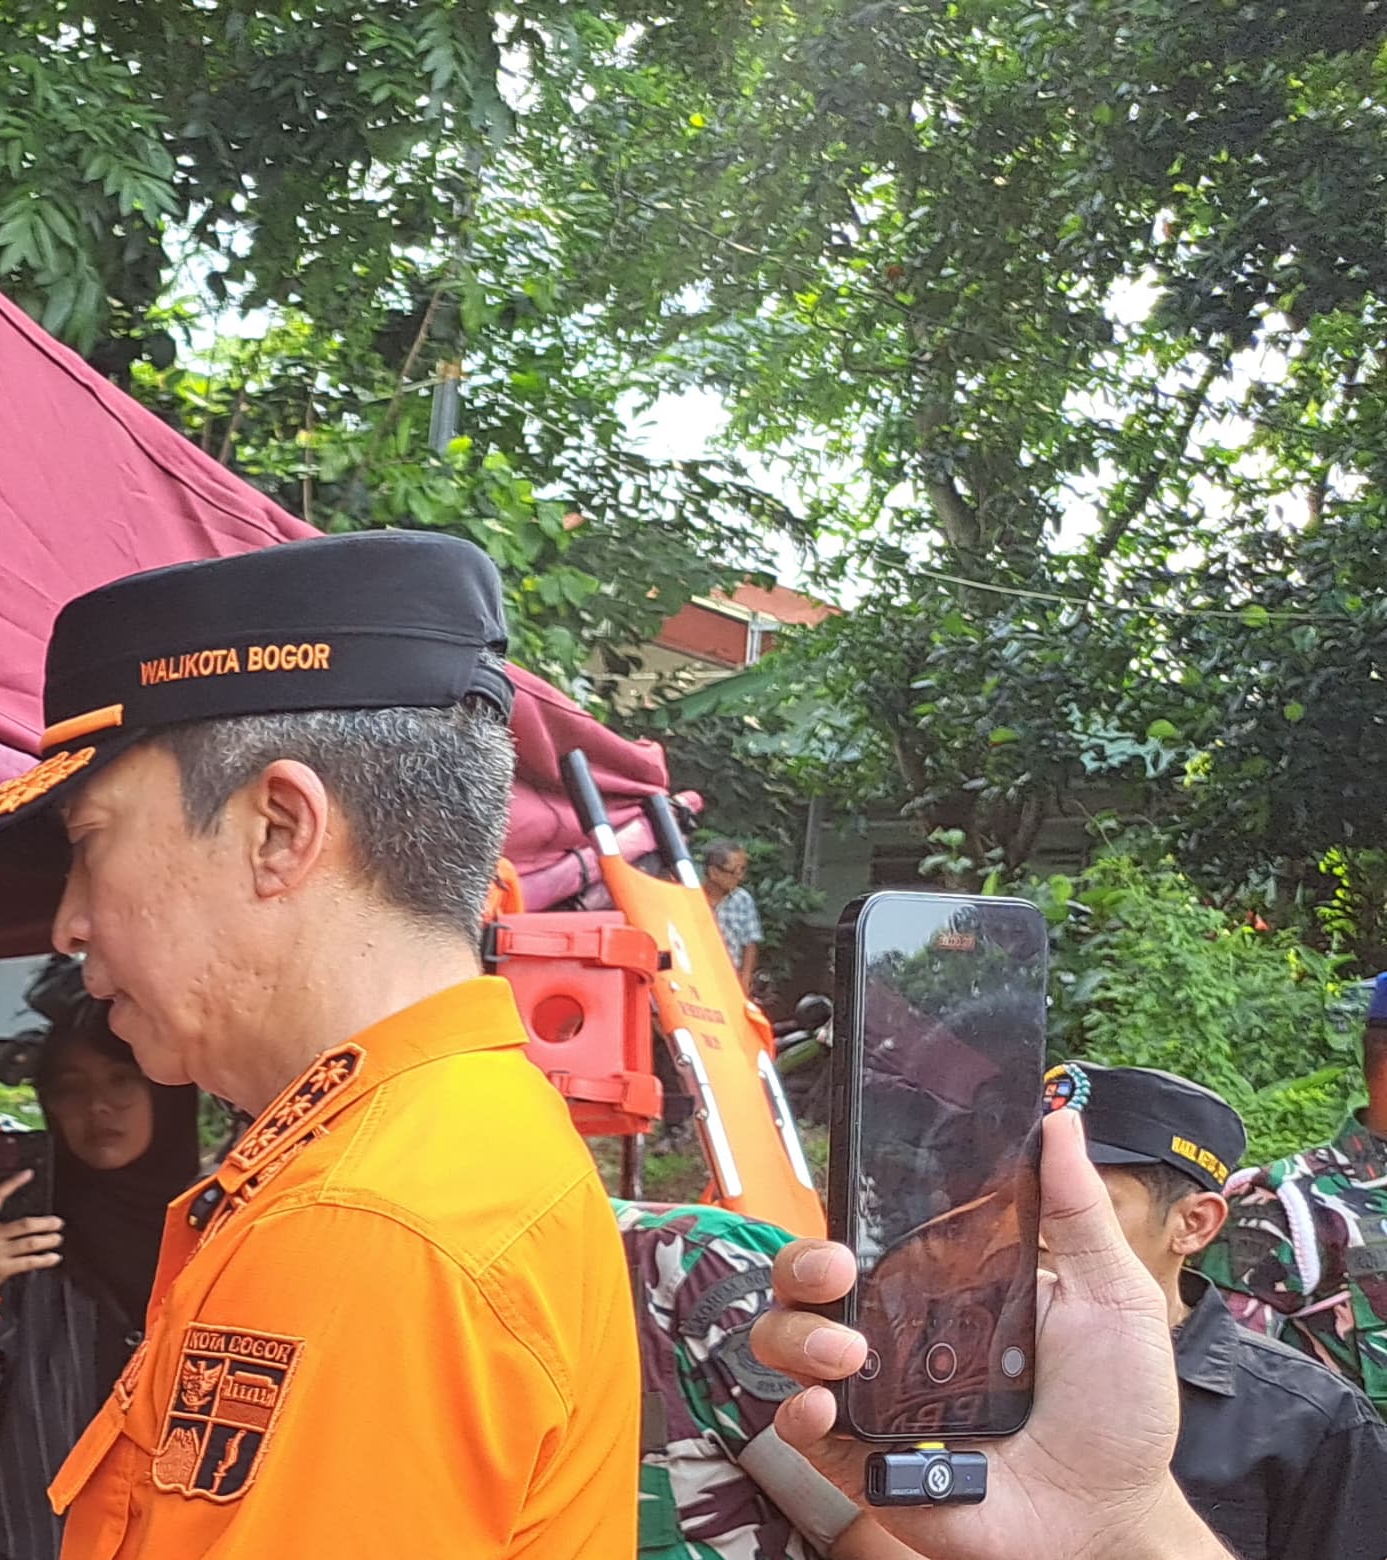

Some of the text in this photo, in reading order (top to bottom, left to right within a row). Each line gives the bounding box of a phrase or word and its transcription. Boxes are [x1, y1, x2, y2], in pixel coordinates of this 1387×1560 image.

[139, 643, 332, 687] WALIKOTA BOGOR
[189, 1329, 295, 1364] KOTA BOGOR
